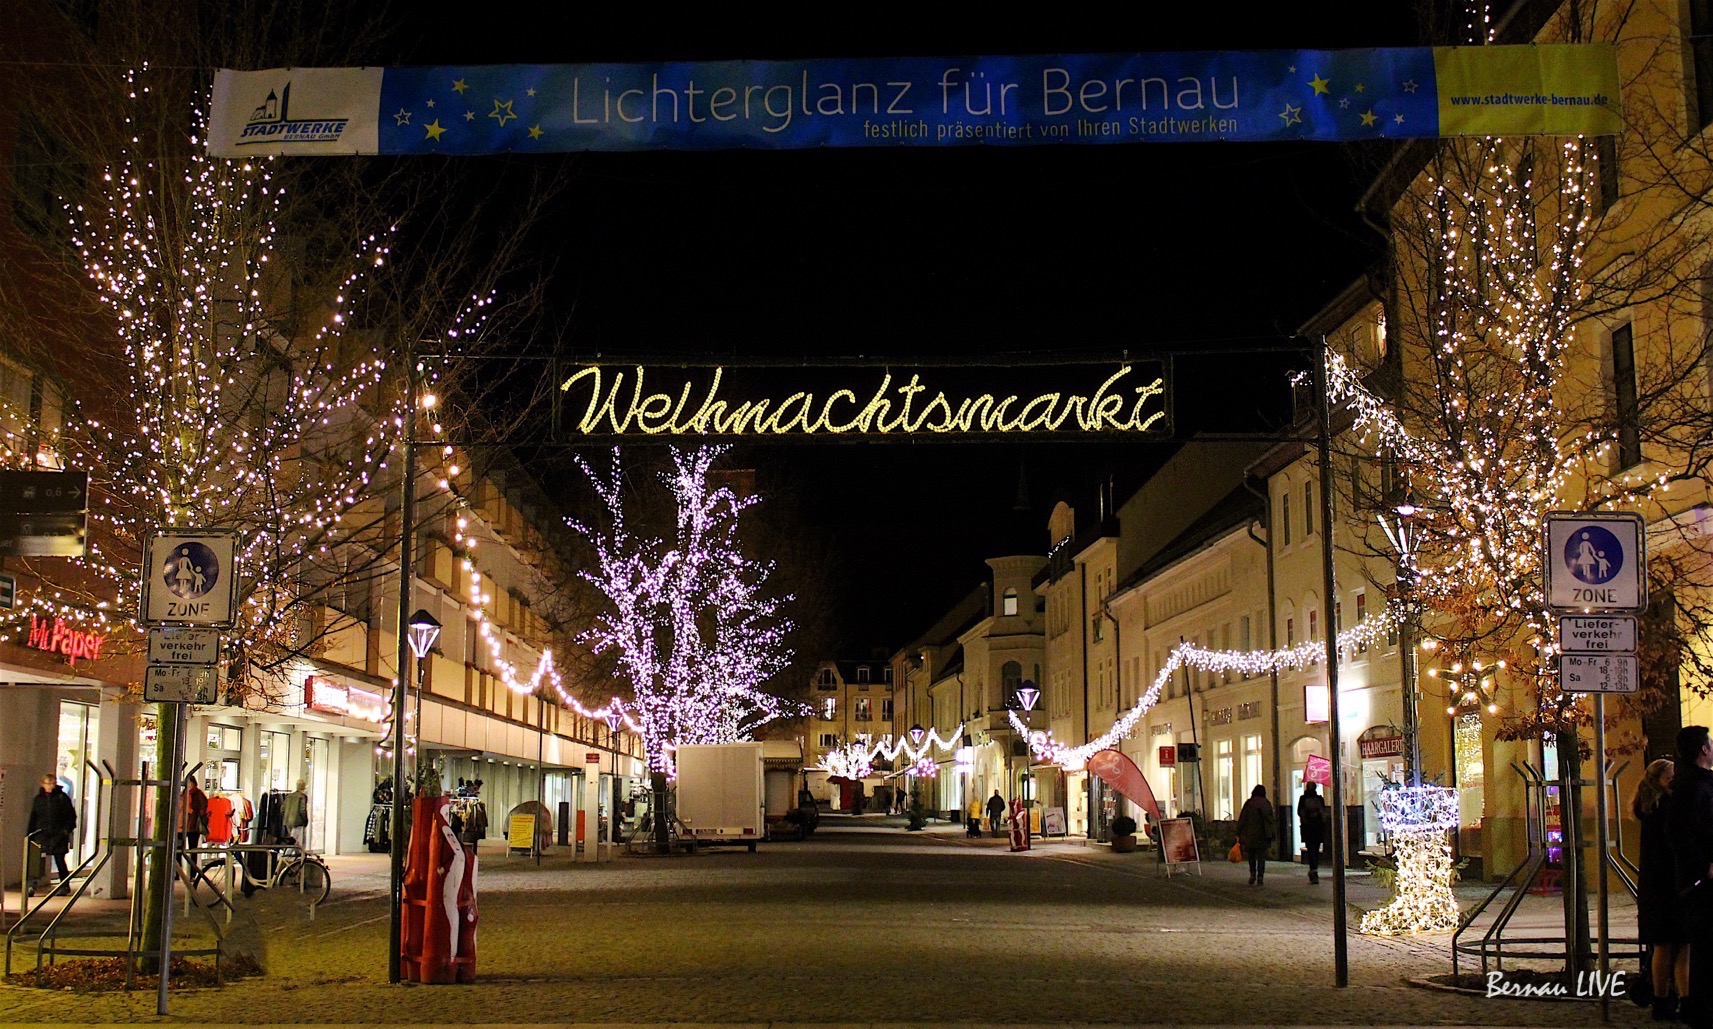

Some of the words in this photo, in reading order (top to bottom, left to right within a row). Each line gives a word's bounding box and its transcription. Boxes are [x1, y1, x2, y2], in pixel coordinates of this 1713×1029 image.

[572, 69, 914, 133] Lichterglanz
[938, 68, 1018, 116] für
[1044, 68, 1240, 115] Bernau
[1451, 93, 1608, 106] www.stadtwerke-bernau.de
[241, 122, 347, 137] STADTWERKE
[864, 119, 928, 138] festlich
[937, 119, 1032, 142] präsentiert
[1040, 123, 1069, 137] von
[1078, 117, 1122, 136] Ihren
[1130, 116, 1238, 135] Stadtwerken
[560, 365, 1165, 434] Weihnachtsmarkt
[1573, 588, 1617, 603] ZONE
[168, 602, 210, 617] ZONE
[1575, 619, 1620, 629] Liefer-
[27, 615, 104, 665] McPaper
[1572, 629, 1622, 639] verkehr
[160, 641, 206, 651] verkehr
[1586, 639, 1609, 649] frei
[171, 651, 192, 660] frei
[1569, 673, 1581, 682] Sa
[153, 683, 164, 692] Sa
[1361, 739, 1403, 756] HAARGALERI
